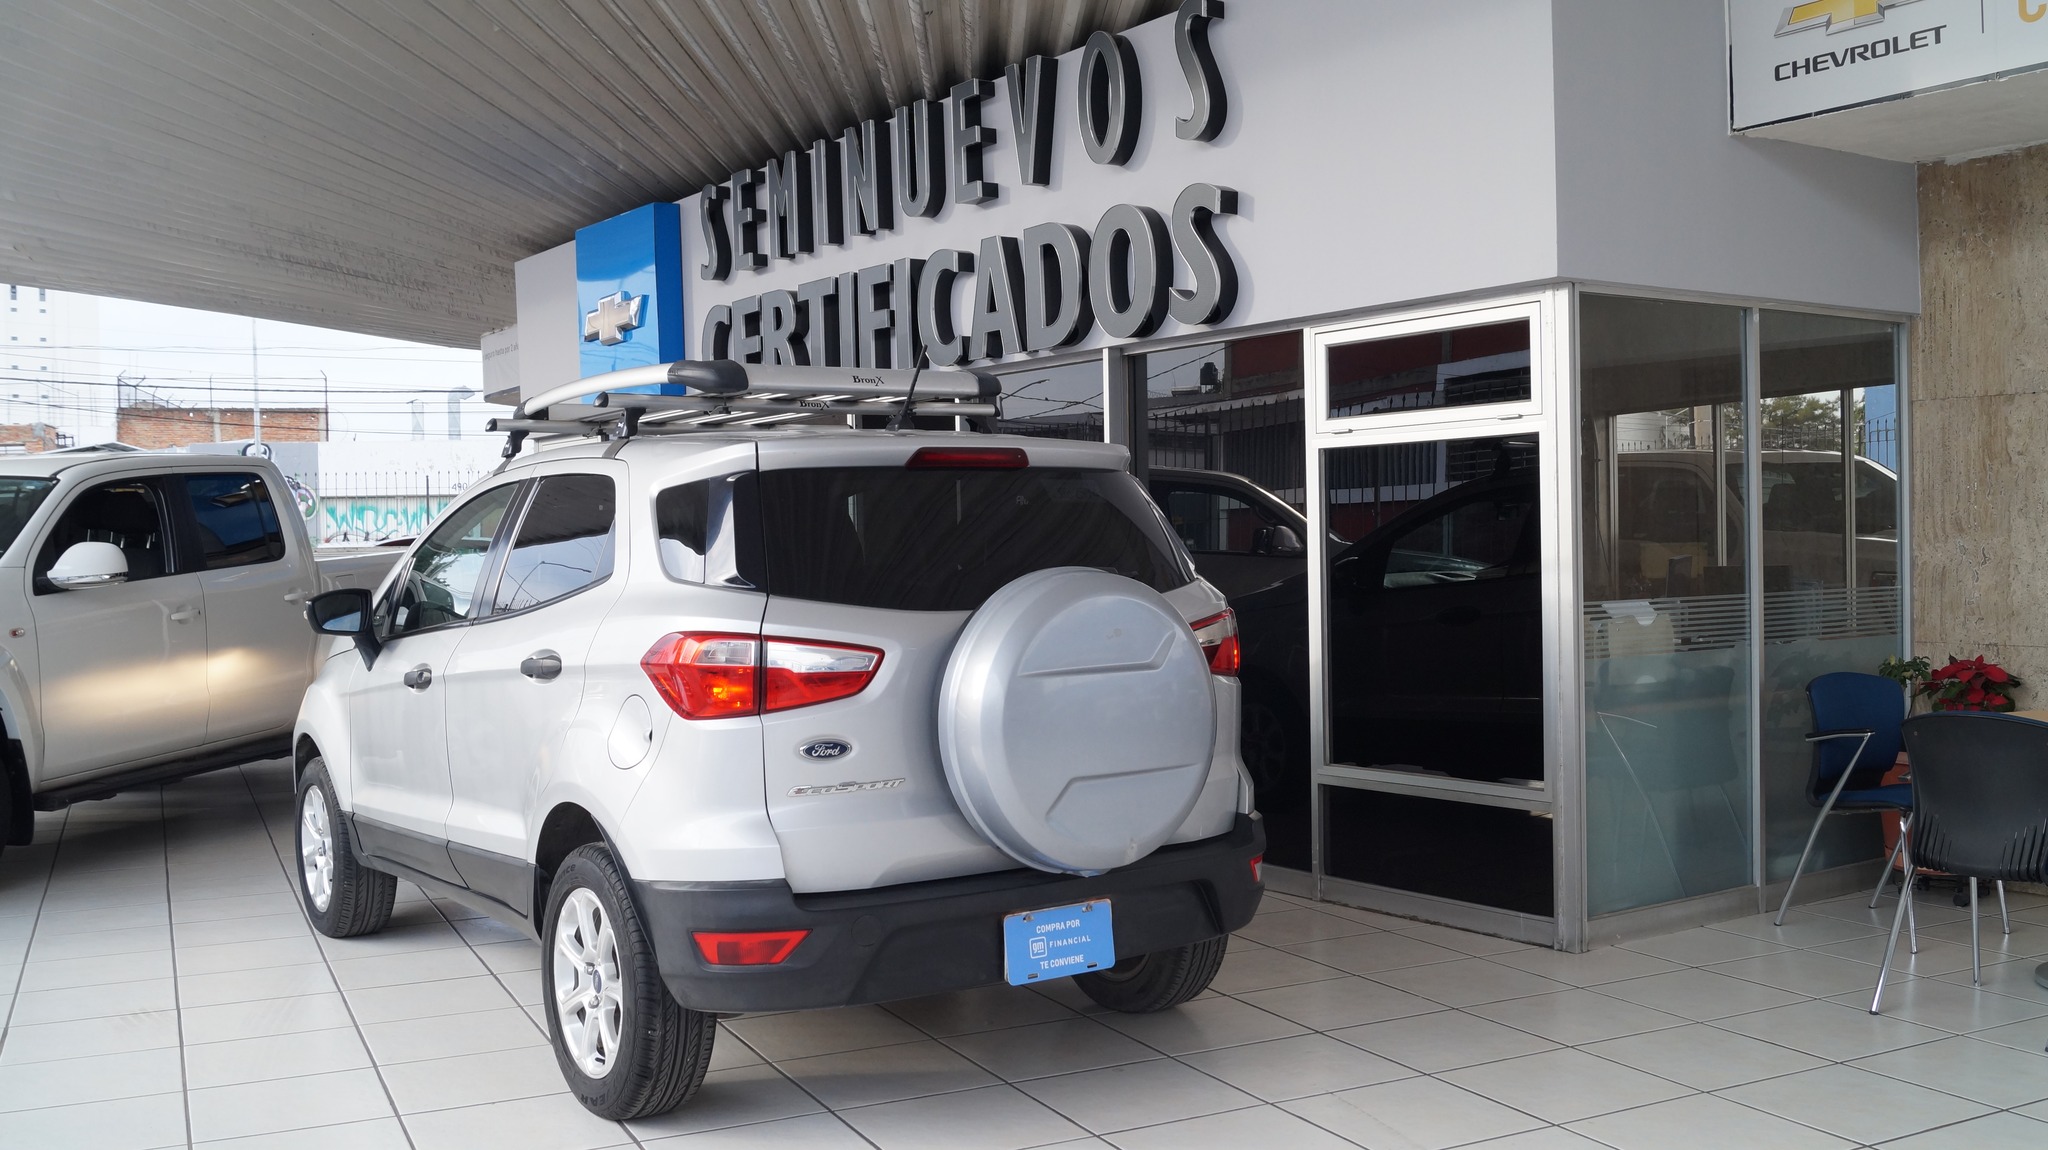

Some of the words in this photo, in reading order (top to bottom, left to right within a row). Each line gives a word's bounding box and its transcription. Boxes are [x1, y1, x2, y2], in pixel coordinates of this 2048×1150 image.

[1774, 24, 1948, 82] CHEVROLET
[701, 0, 1227, 281] SEMINUEVOS
[701, 183, 1239, 368] CERTIFICADOS
[852, 375, 884, 387] BronX
[800, 400, 830, 411] BronX
[811, 743, 840, 757] Ford
[1036, 921, 1066, 934] COMPRA
[1066, 920, 1080, 928] POR
[1049, 935, 1091, 948] FINANCIAL
[1040, 961, 1049, 970] TE
[1050, 954, 1084, 967] CONVIENE
